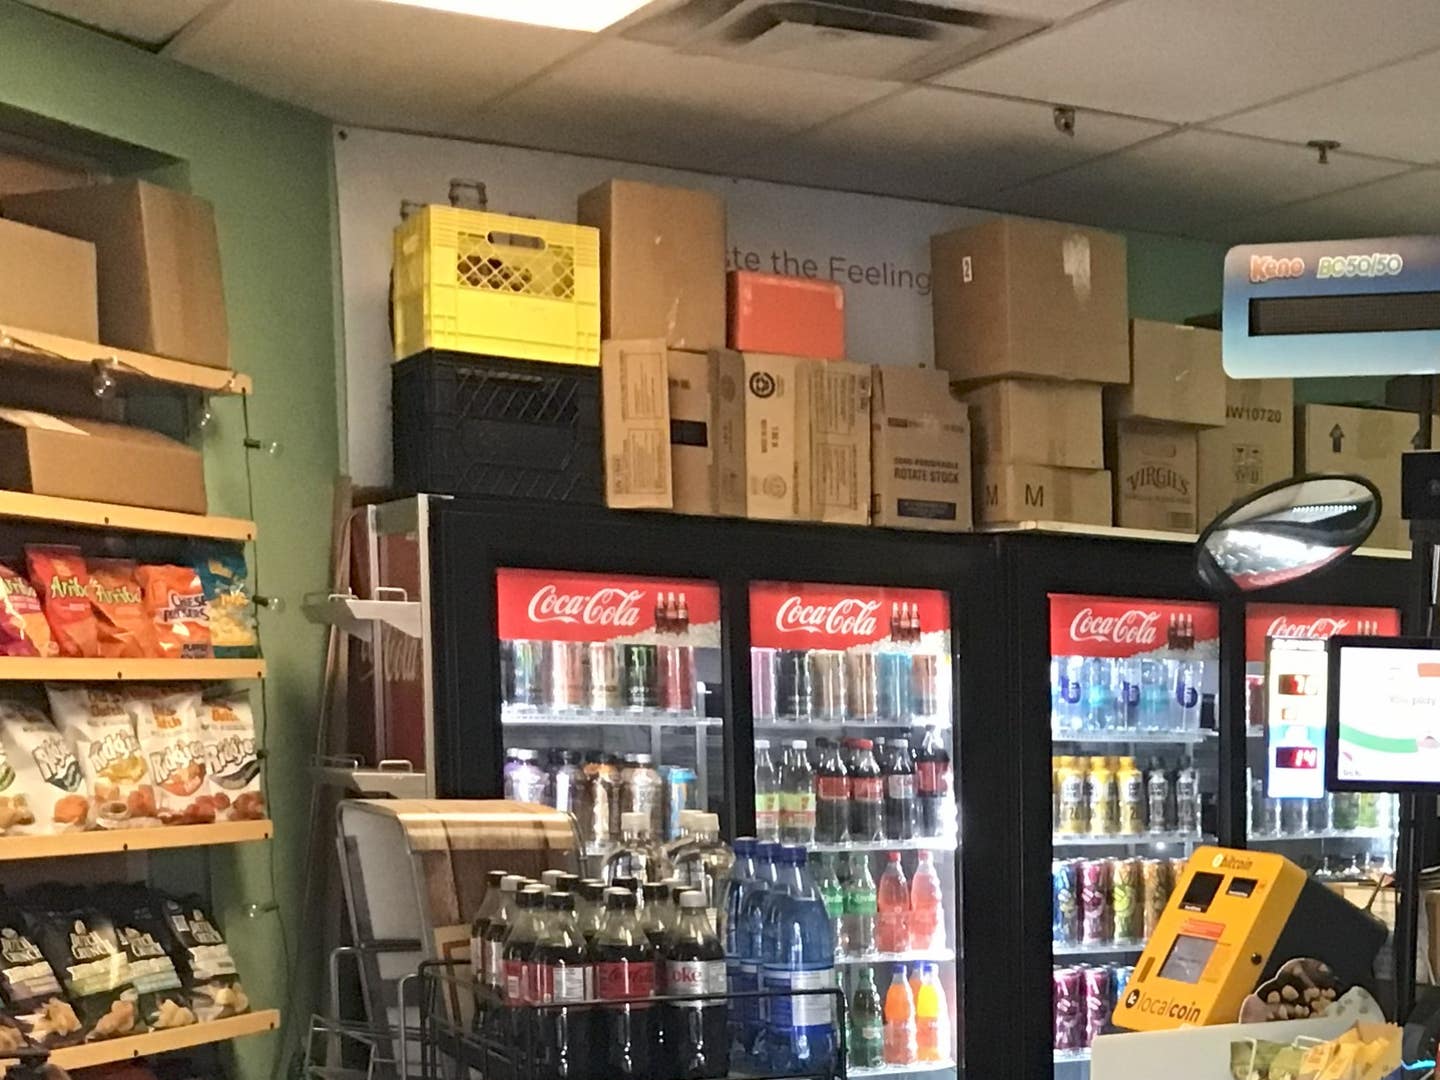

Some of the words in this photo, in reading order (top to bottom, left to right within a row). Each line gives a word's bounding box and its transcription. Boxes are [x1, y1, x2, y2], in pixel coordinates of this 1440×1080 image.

[771, 249, 818, 279] the
[828, 256, 932, 296] Feeling
[893, 467, 928, 482] ROTATE
[930, 469, 960, 484] STOCK
[1025, 483, 1044, 507] M
[528, 584, 647, 627] Coca-Cola
[776, 595, 882, 637] Coca-Cola
[1070, 607, 1162, 645] Coca-Cola
[672, 966, 702, 983] oke
[1136, 994, 1202, 1024] localcoin
